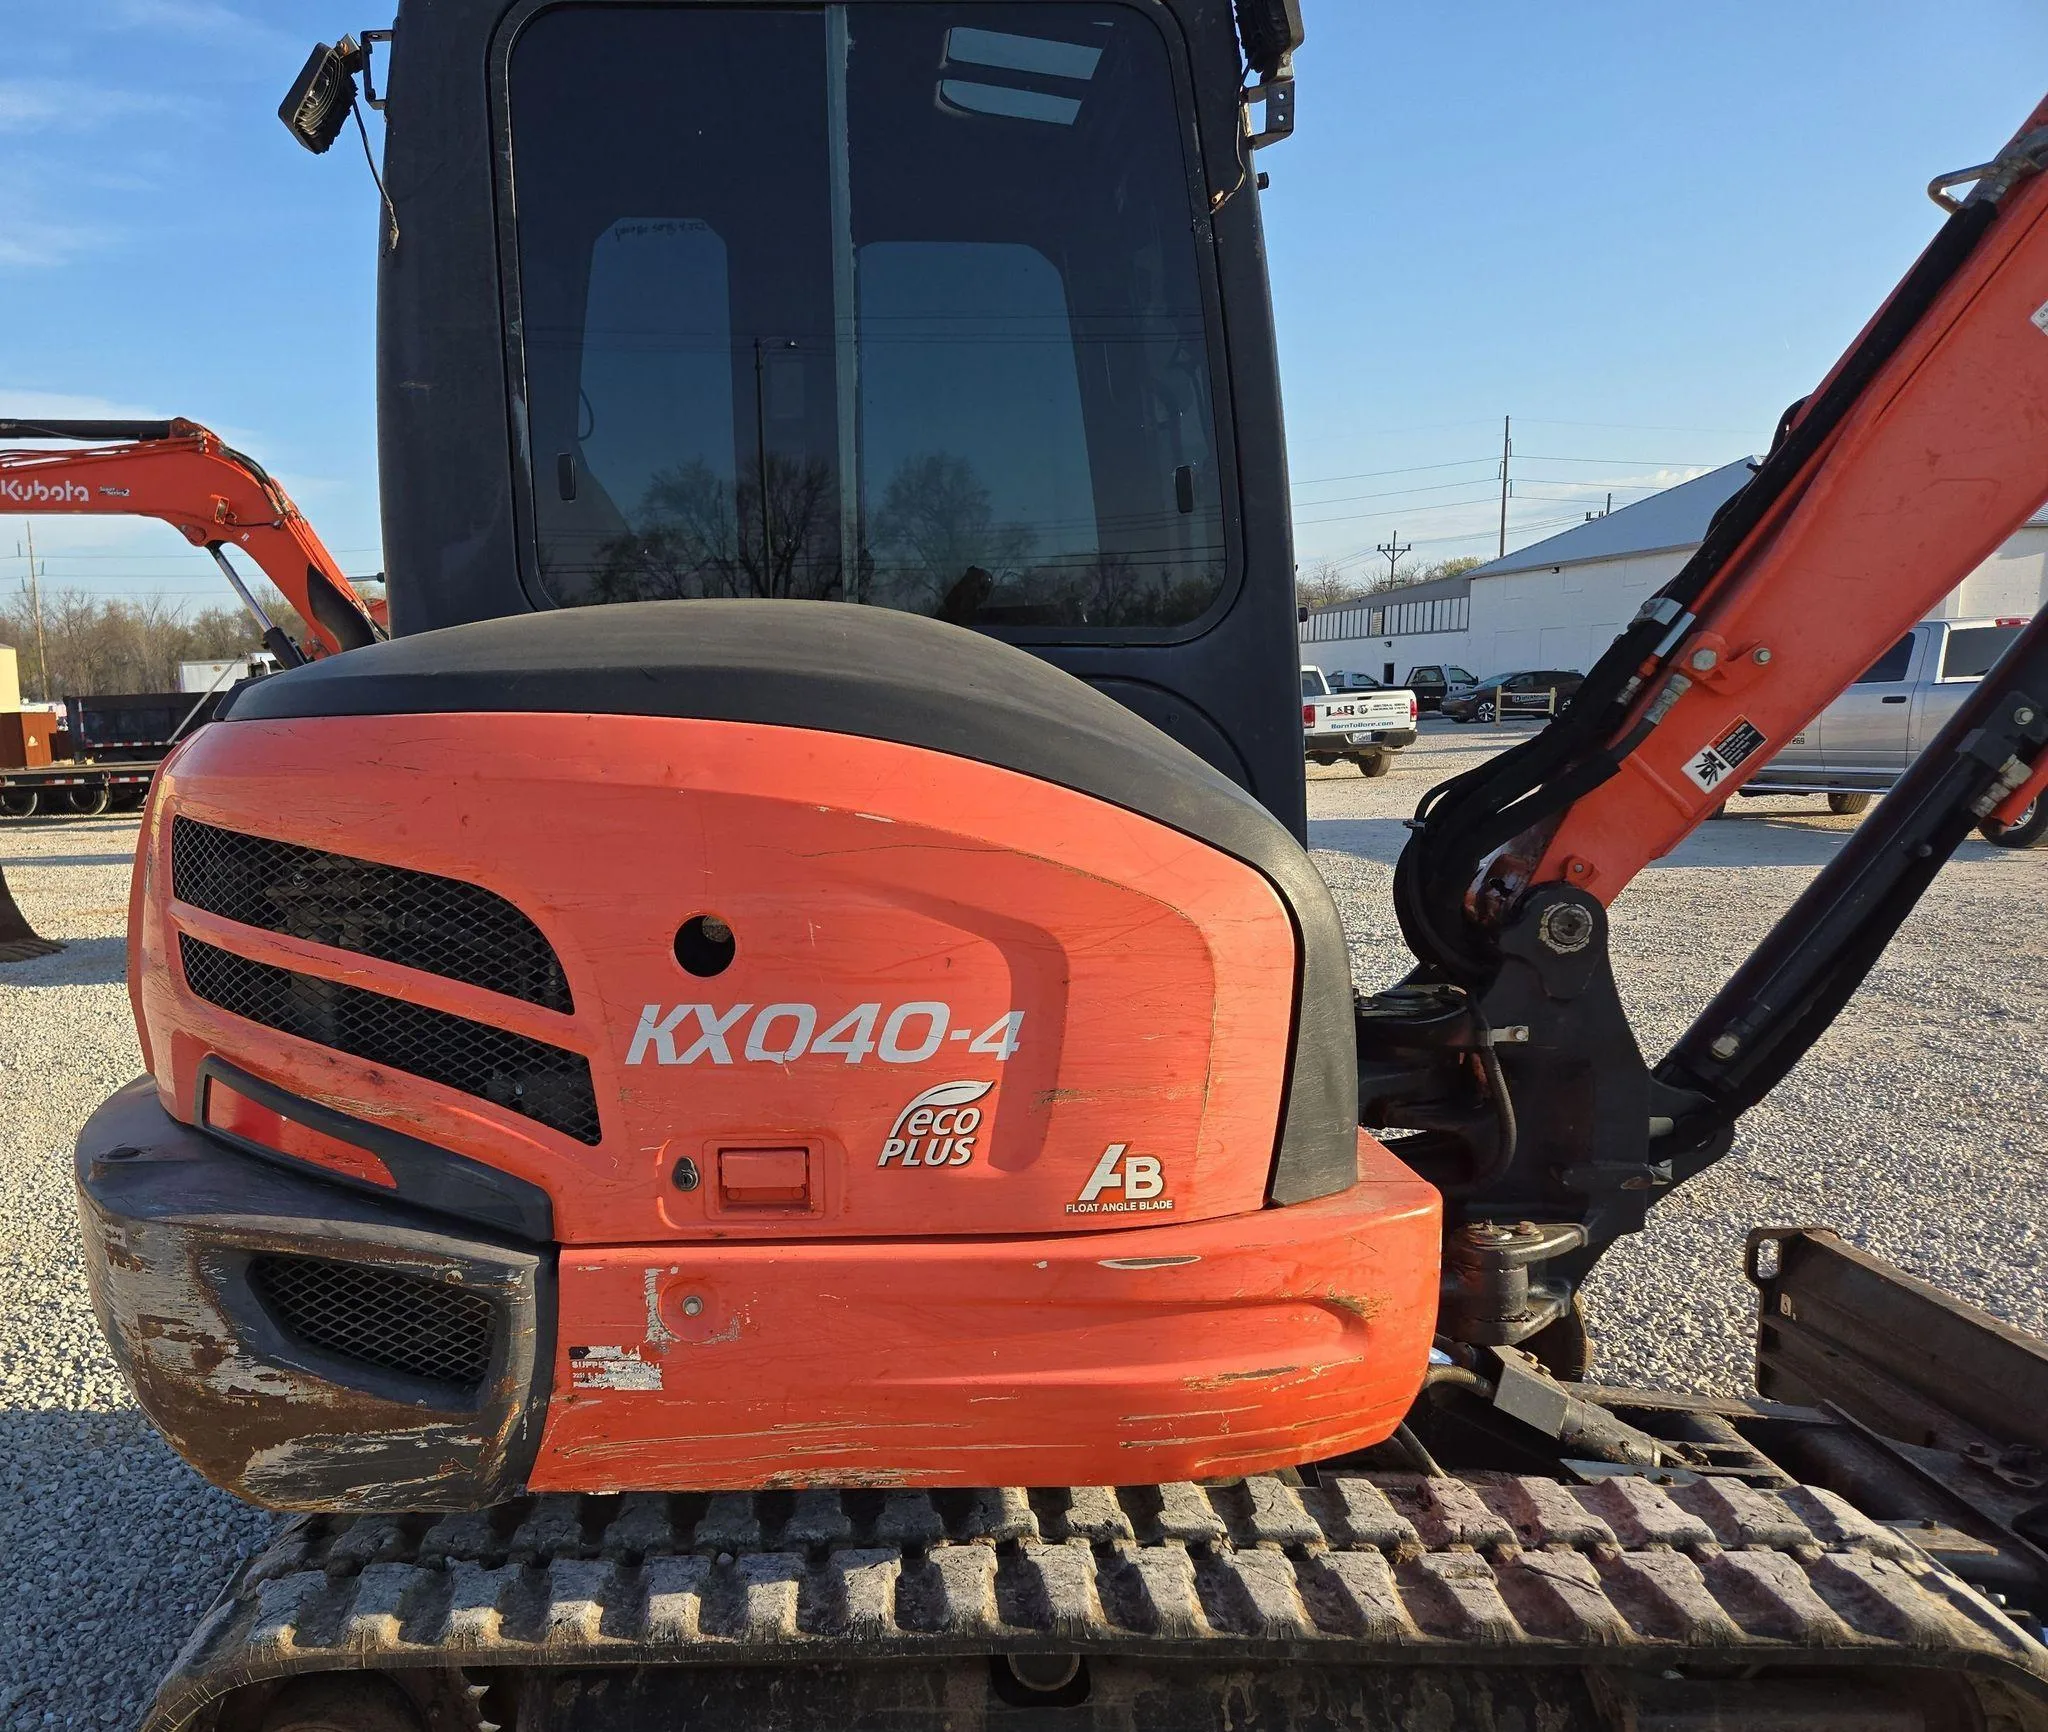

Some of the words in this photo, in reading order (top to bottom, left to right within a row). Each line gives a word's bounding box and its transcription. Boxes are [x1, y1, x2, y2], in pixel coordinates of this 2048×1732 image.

[1, 479, 89, 501] Kubota
[1789, 737, 1805, 745] 269
[624, 1001, 1025, 1065] KX040-4
[908, 1108, 980, 1136] eco
[877, 1137, 976, 1167] PLUS
[1077, 1144, 1164, 1200] AB
[1066, 1203, 1099, 1213] FLOAT
[1101, 1202, 1137, 1212] ANGLE
[1139, 1200, 1173, 1211] BLADE
